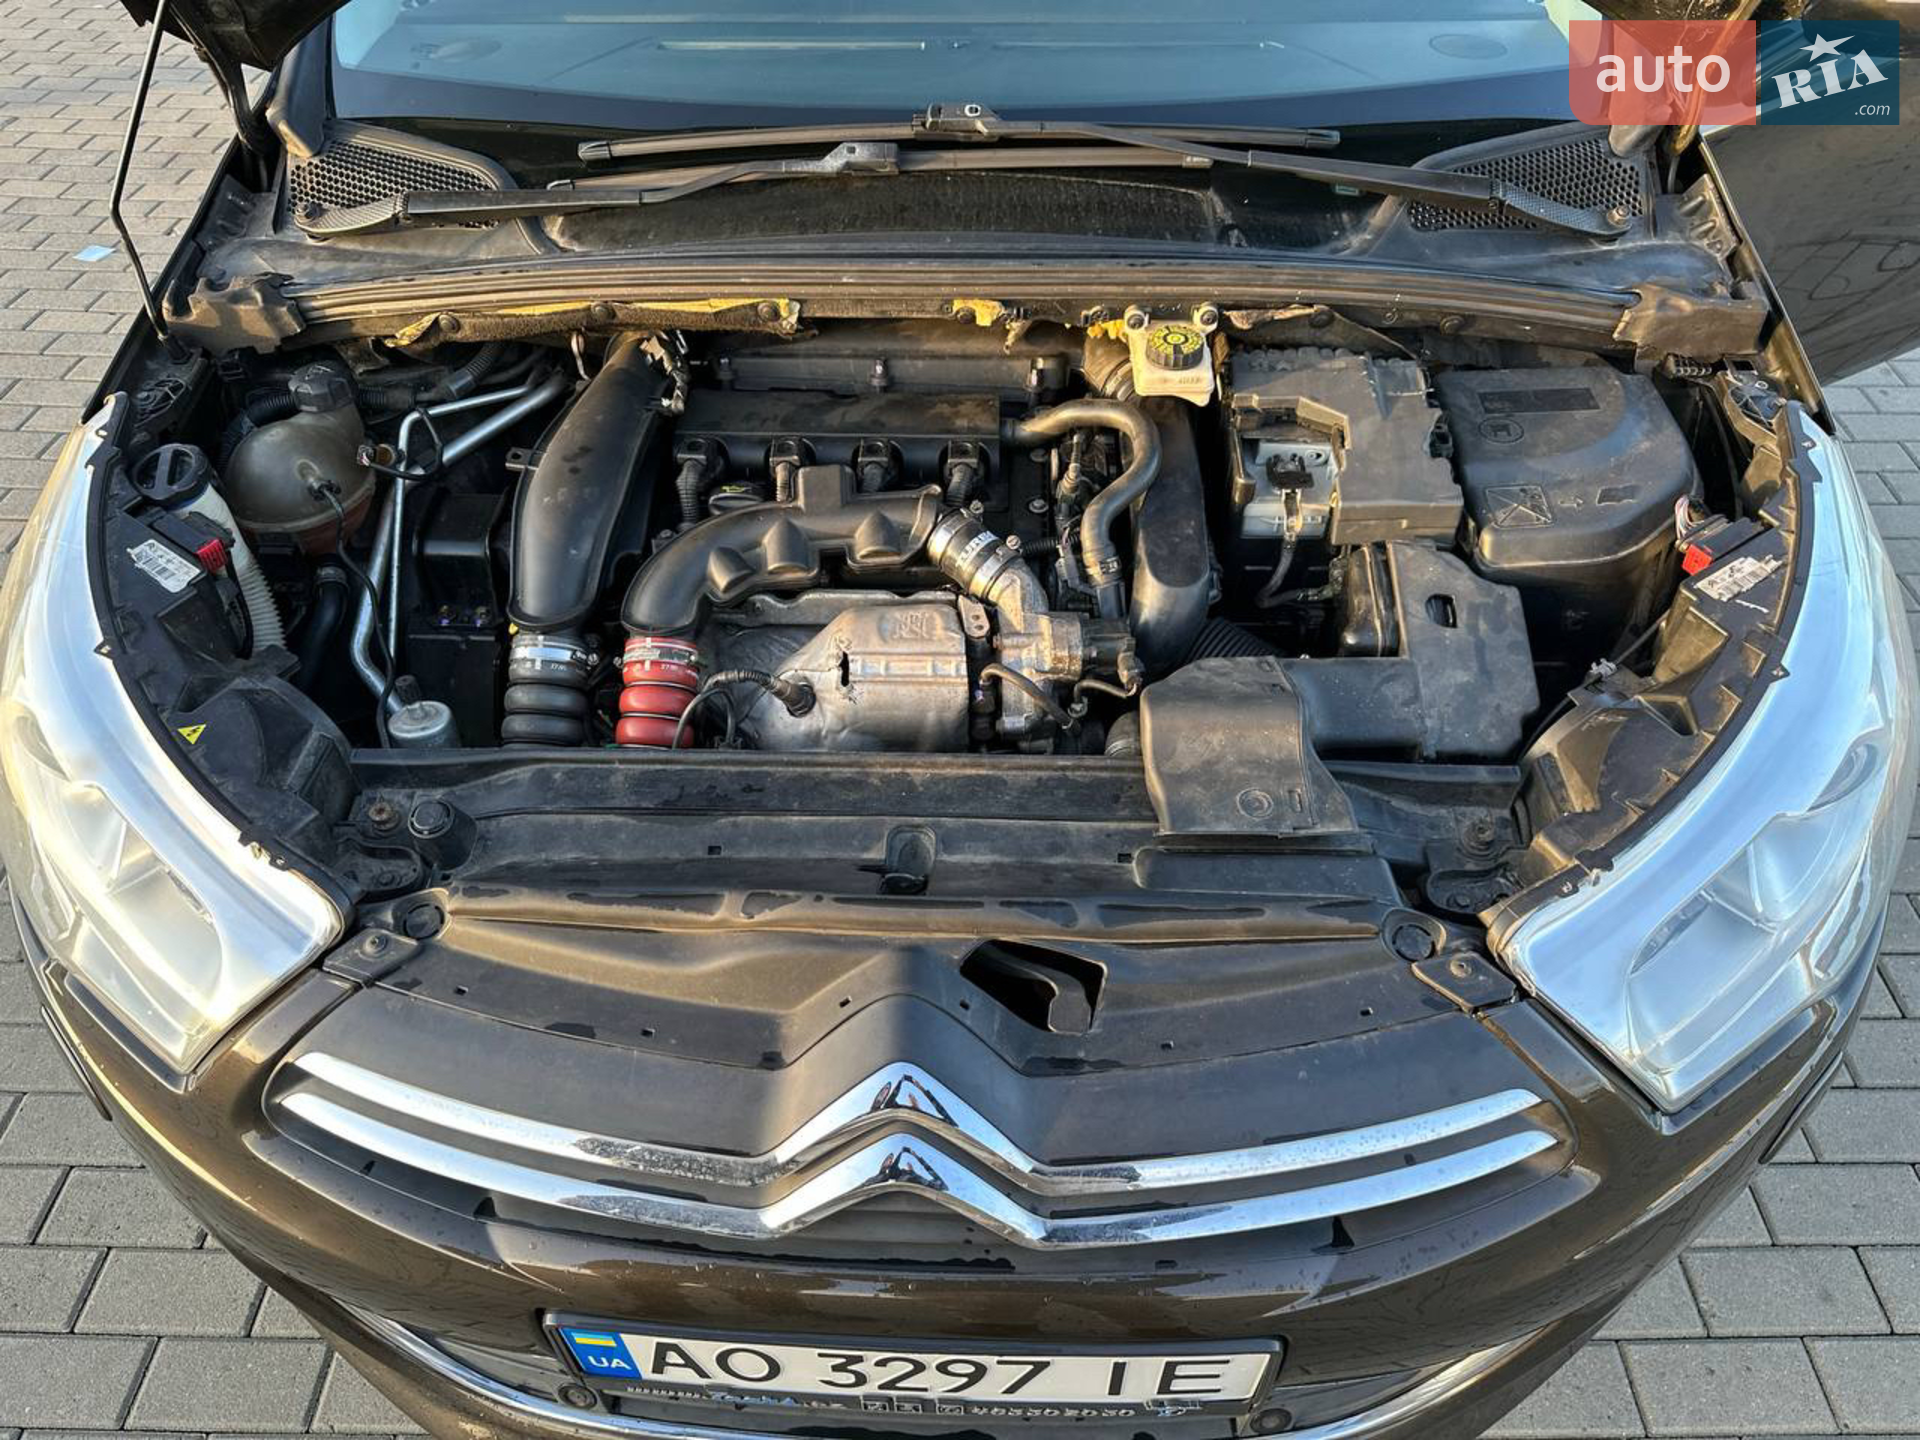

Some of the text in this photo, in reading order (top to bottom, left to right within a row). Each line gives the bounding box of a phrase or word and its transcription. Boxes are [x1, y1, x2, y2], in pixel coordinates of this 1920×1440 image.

[589, 1355, 632, 1371] UA
[652, 1342, 1231, 1395] AO 3297 IE
